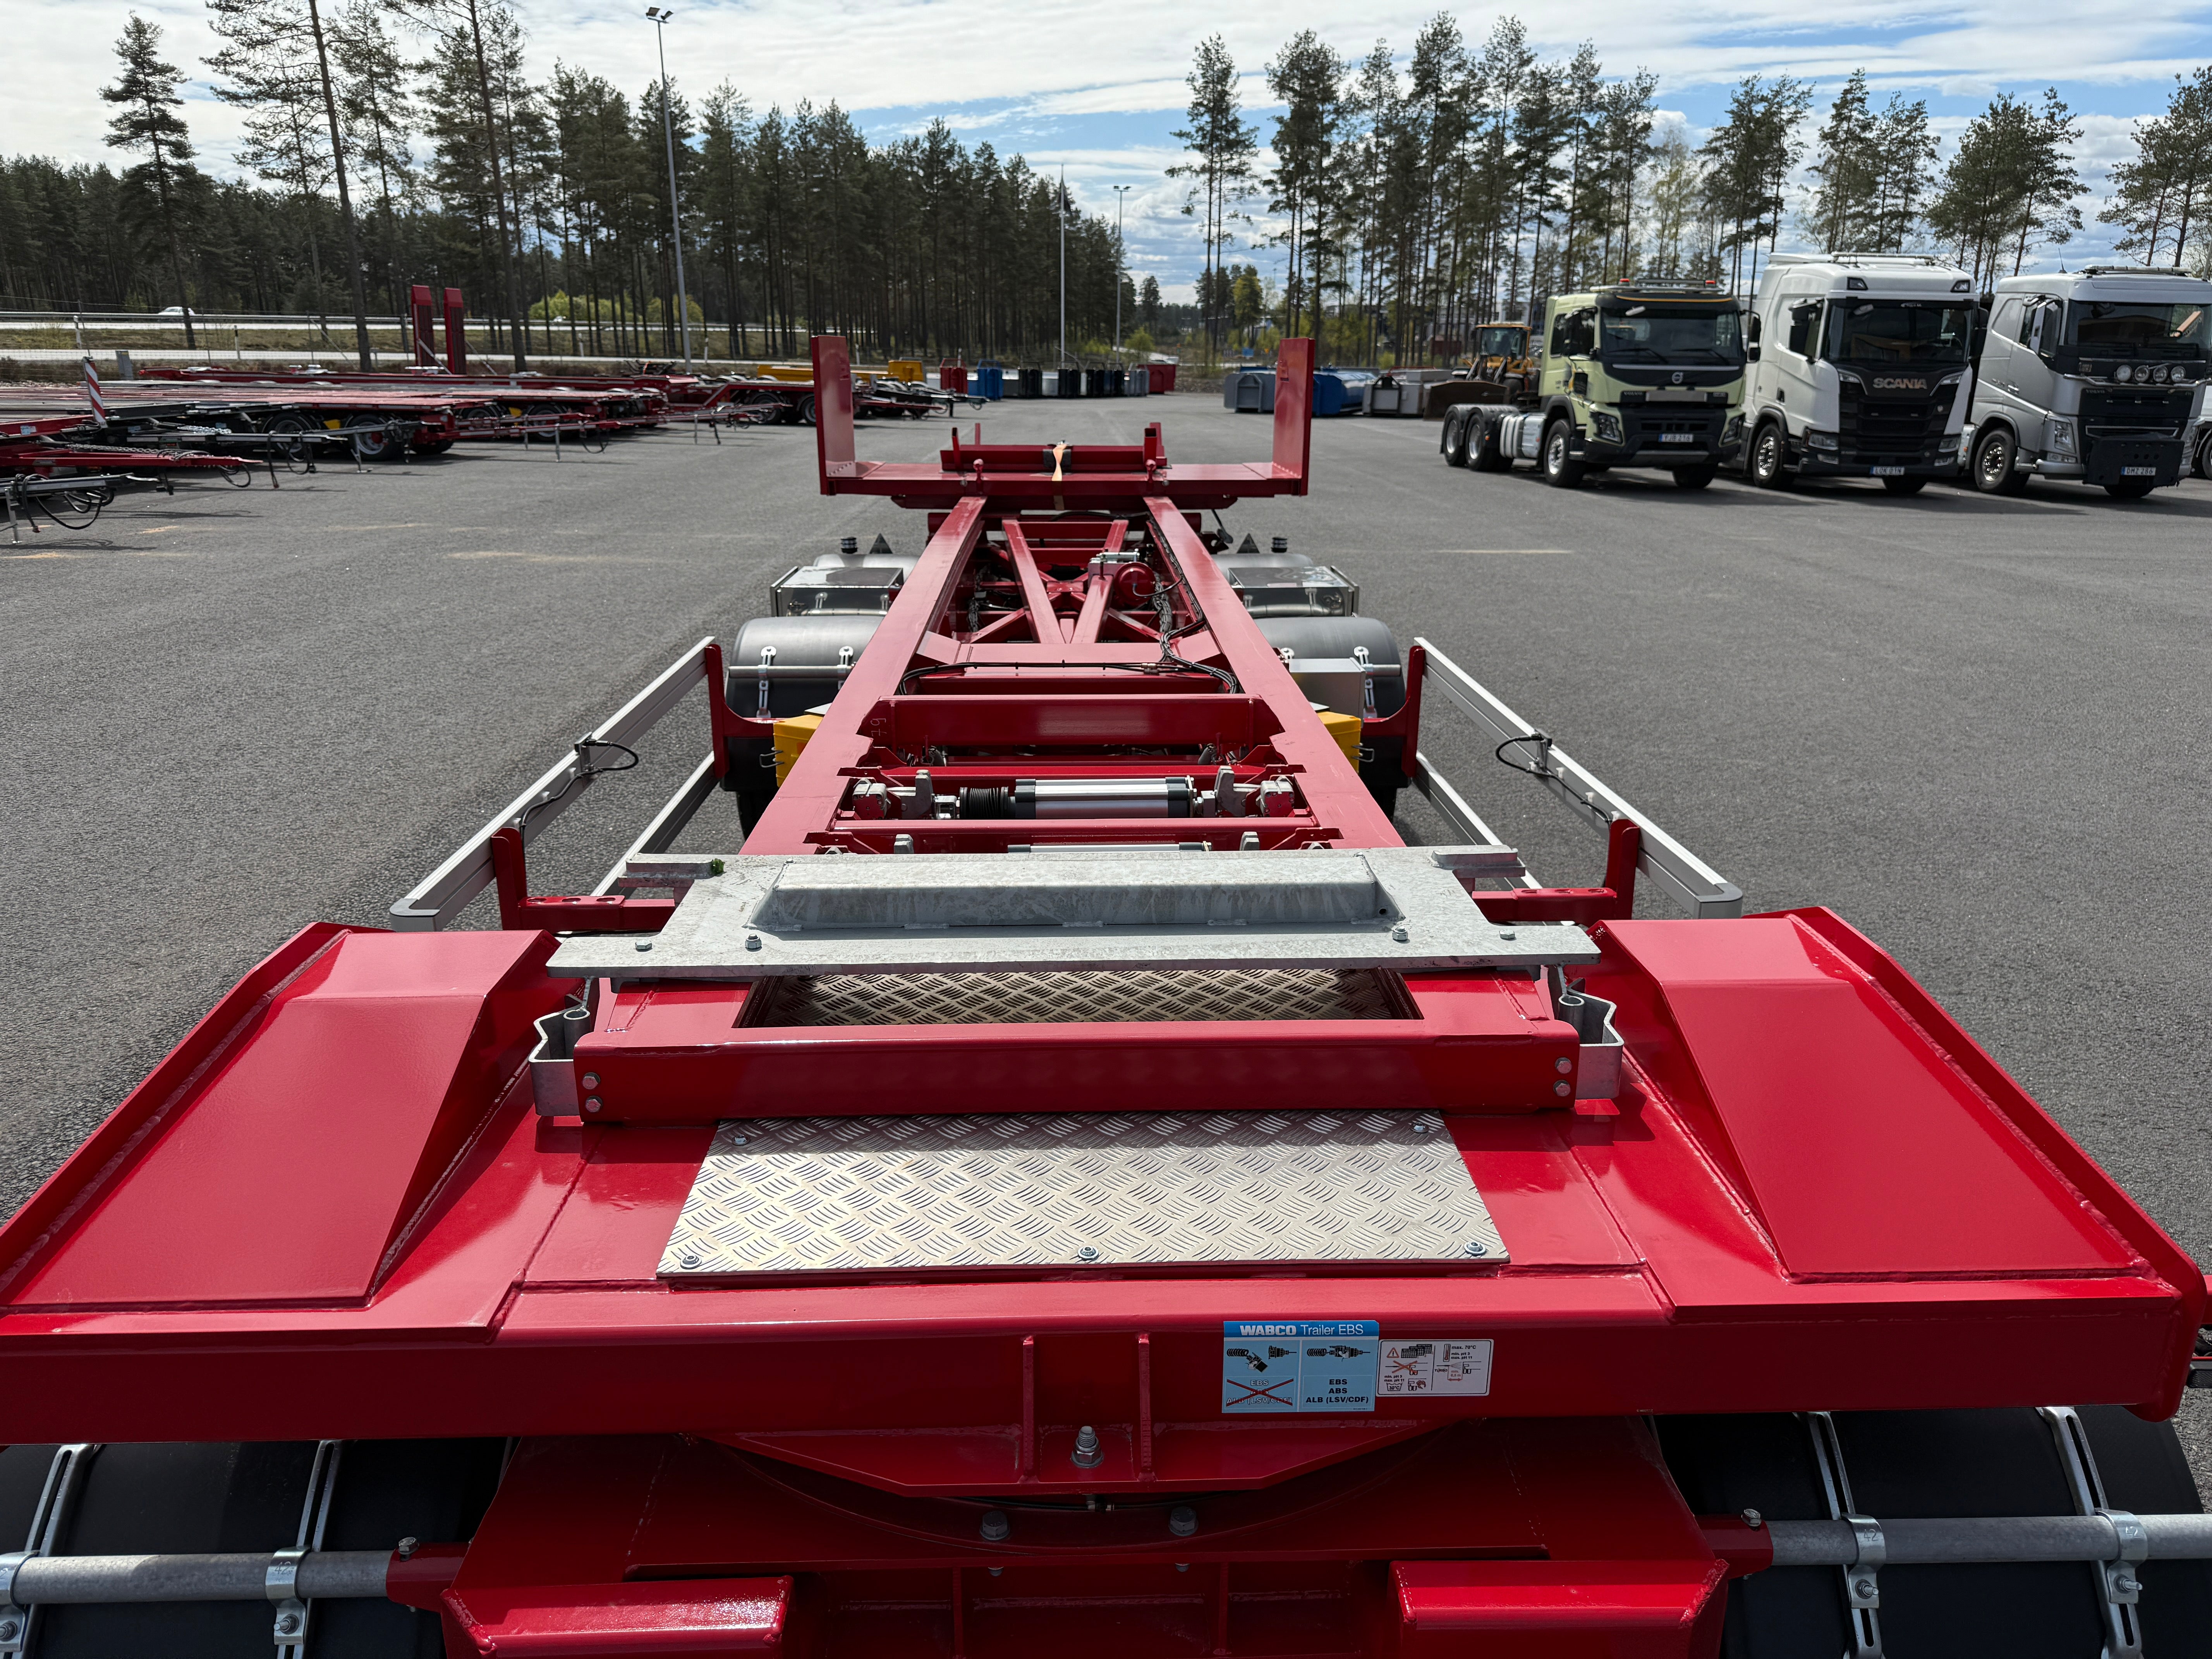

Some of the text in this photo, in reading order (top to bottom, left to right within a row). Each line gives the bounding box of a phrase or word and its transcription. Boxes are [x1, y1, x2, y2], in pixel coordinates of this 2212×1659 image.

[1873, 378, 1927, 389] SCANIA
[1240, 1324, 1364, 1336] WABCO Trailer EBS
[1864, 1529, 1879, 1542] 42
[2125, 1526, 2141, 1538] 42
[274, 1561, 291, 1575] 42
